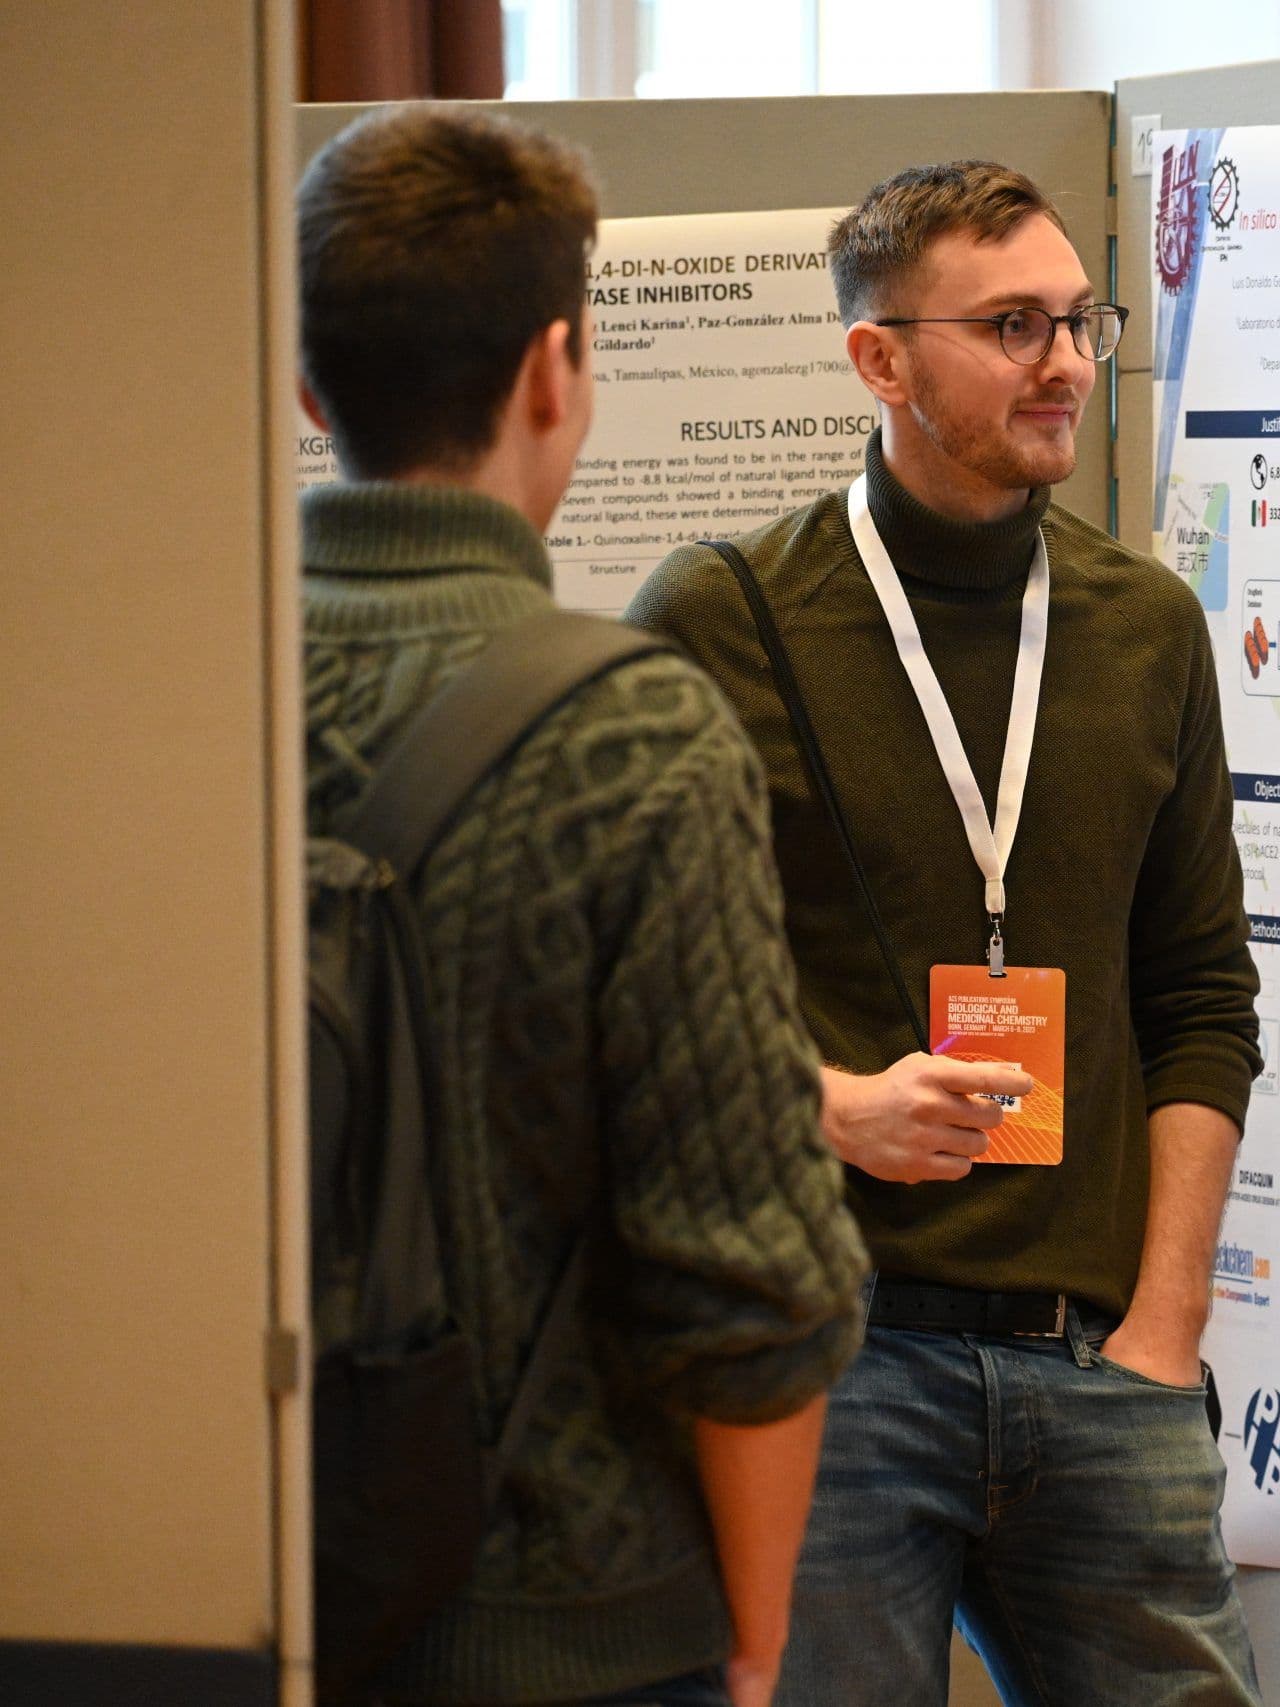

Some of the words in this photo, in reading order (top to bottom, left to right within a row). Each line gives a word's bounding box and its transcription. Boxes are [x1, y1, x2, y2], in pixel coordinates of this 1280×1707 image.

[1251, 209, 1277, 230] silico
[745, 252, 828, 271] DERIVAT
[584, 288, 630, 306] TASE
[636, 283, 752, 302] INHIBITORS
[788, 313, 822, 324] Alma
[682, 420, 764, 440] RESULTS
[772, 418, 816, 437] AND
[622, 459, 661, 469] energy
[666, 457, 689, 466] was
[694, 454, 728, 465] found
[733, 454, 746, 464] to
[750, 453, 765, 463] be
[770, 452, 781, 462] in
[786, 451, 806, 462] the
[811, 452, 844, 463] range
[849, 448, 862, 459] of
[1176, 527, 1209, 545] Wuhan
[589, 563, 636, 575] Structure
[1176, 552, 1208, 572] 武汉市
[948, 1003, 999, 1014] BIOLOGICAL
[1000, 1004, 1019, 1015] AND
[948, 1013, 996, 1025] MEDICINAL
[997, 1015, 1048, 1027] CHEMISTRY
